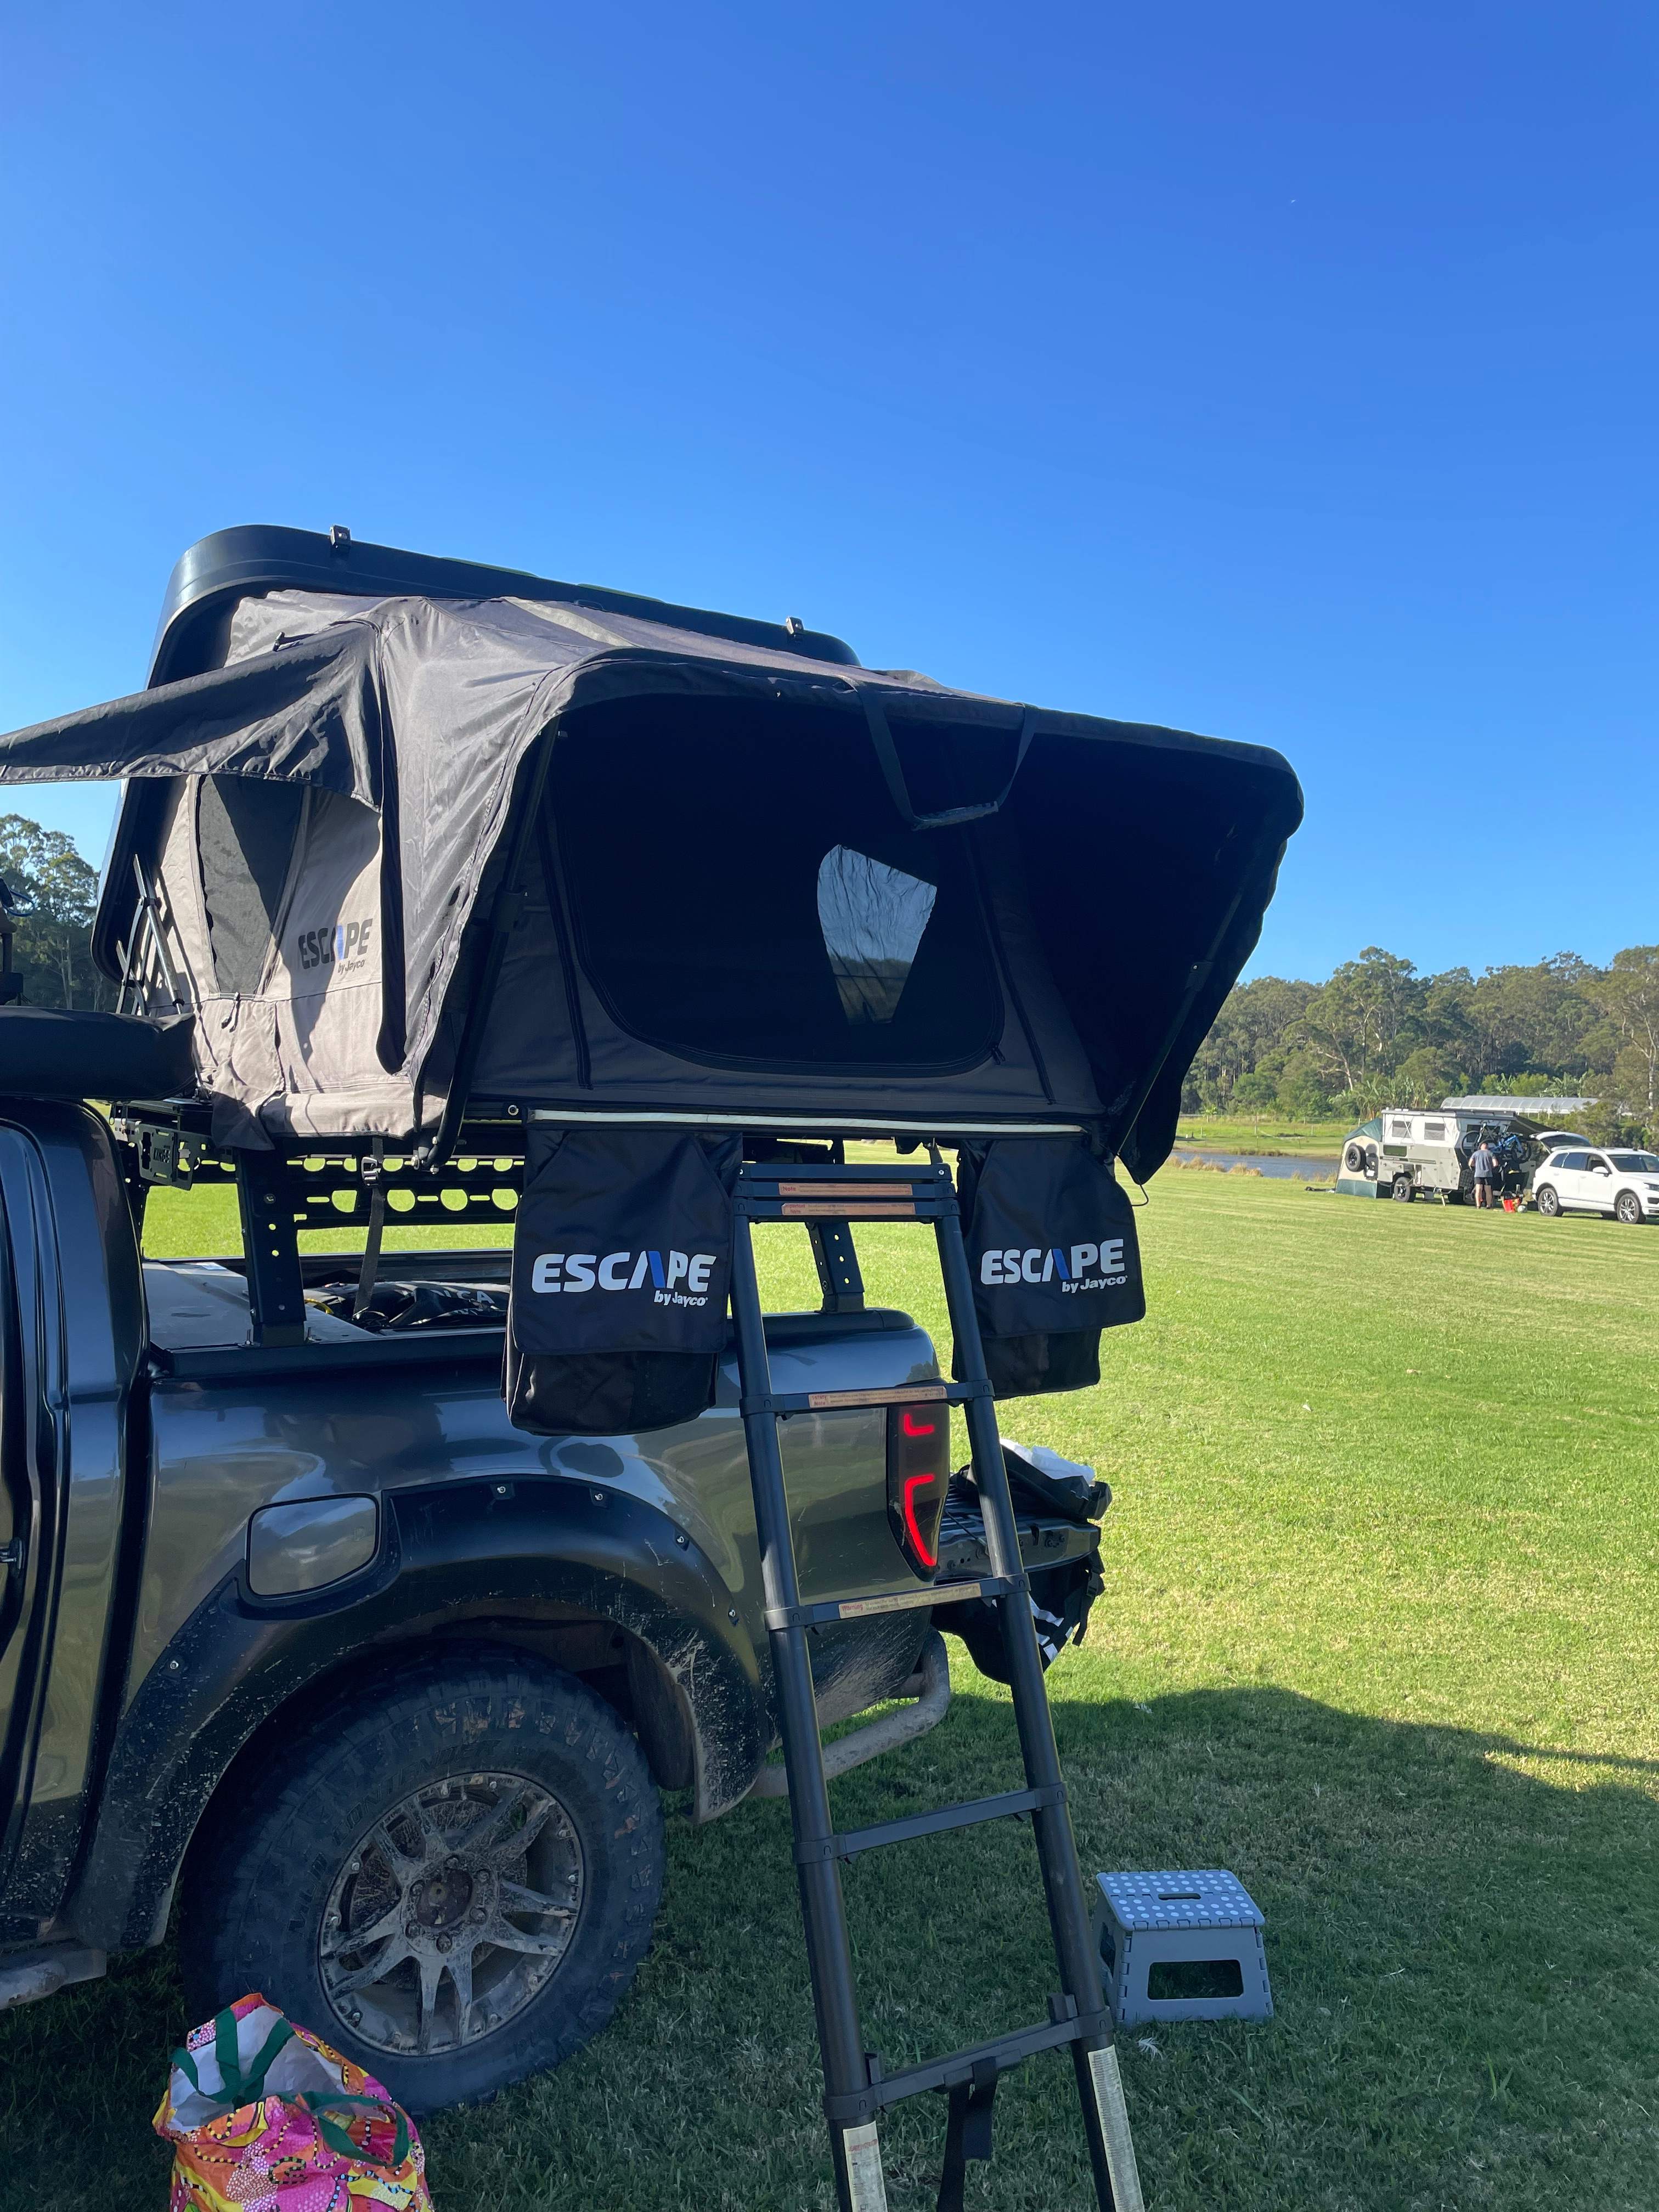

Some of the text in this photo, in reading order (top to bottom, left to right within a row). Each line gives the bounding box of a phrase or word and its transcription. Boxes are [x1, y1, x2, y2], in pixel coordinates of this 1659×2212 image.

[298, 918, 373, 969] ESCAPE
[338, 960, 365, 975] by Jayco
[531, 1250, 716, 1293] ESCAPE
[981, 1238, 1125, 1285] ESCAPE
[654, 1290, 708, 1307] by Jayco
[1062, 1275, 1127, 1293] by Jayco
